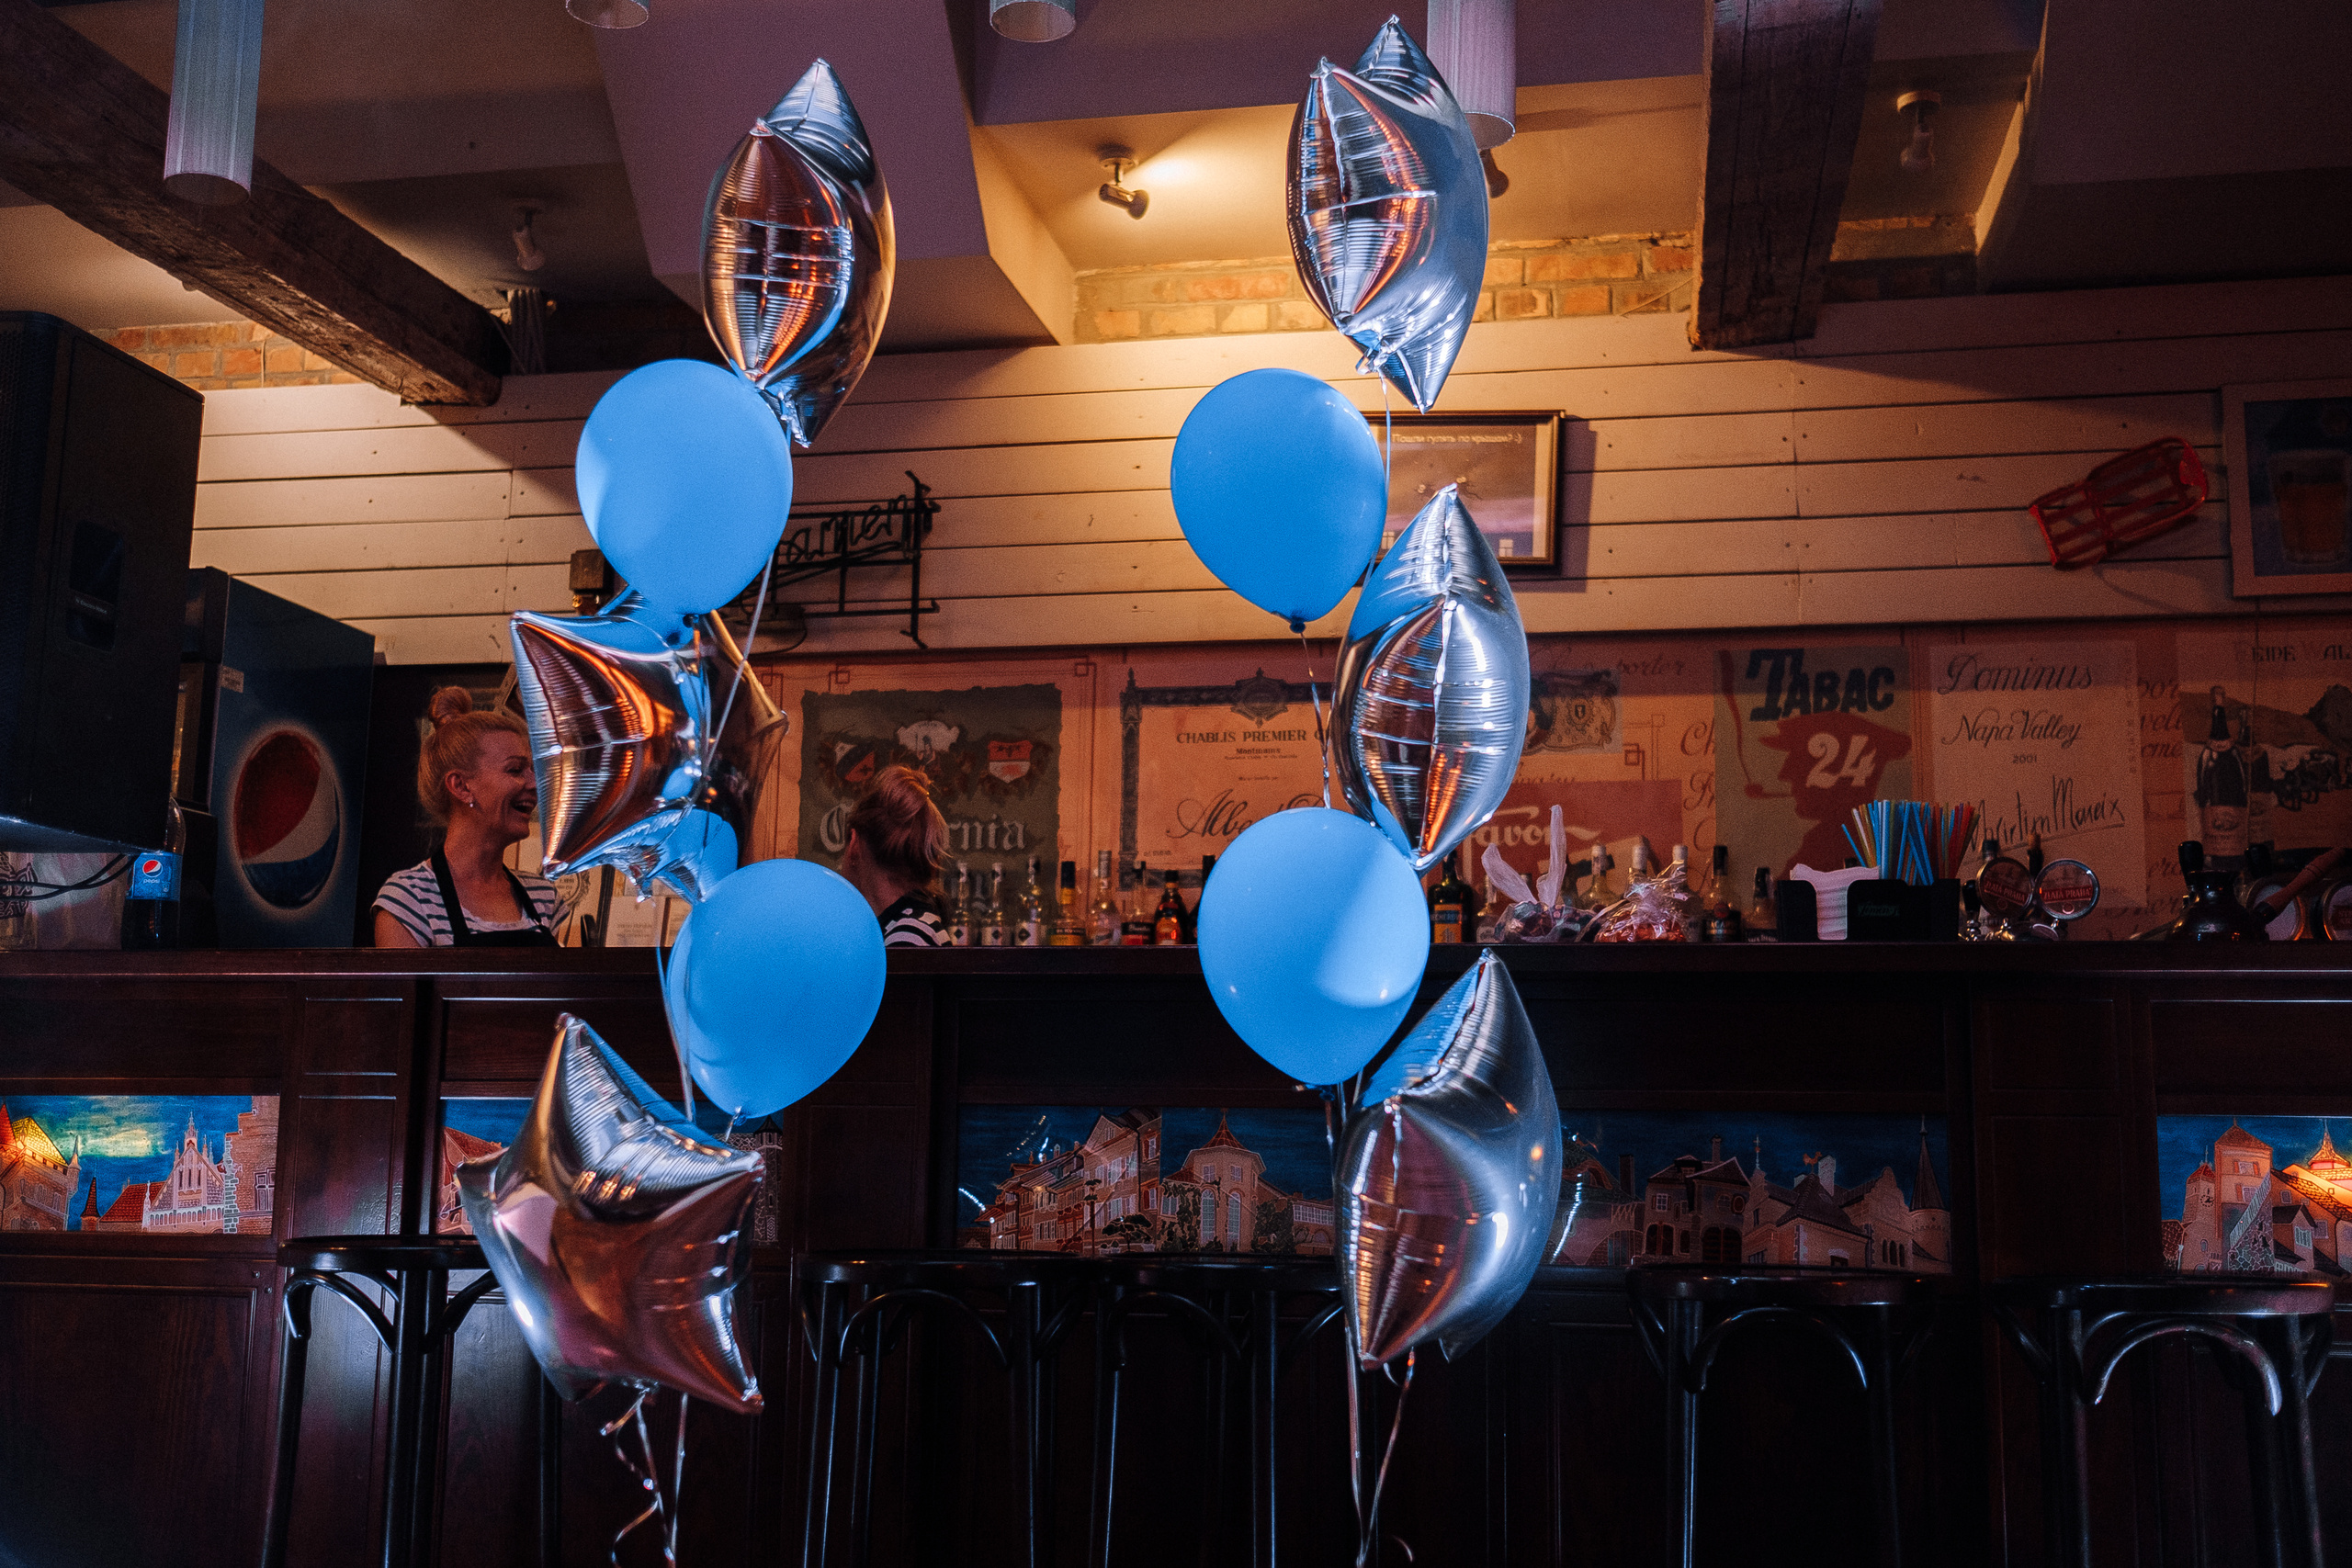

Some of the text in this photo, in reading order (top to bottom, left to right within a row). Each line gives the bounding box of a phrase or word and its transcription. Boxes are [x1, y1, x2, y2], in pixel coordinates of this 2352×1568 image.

[1746, 648, 1895, 722] TABAC
[1937, 652, 2094, 695] Dominus
[1176, 730, 1237, 745] CHABLIS
[1242, 728, 1307, 742] PREMIER
[1940, 707, 2082, 749] Napa Valley
[1805, 732, 1877, 789] 24
[2011, 754, 2038, 764] 2001
